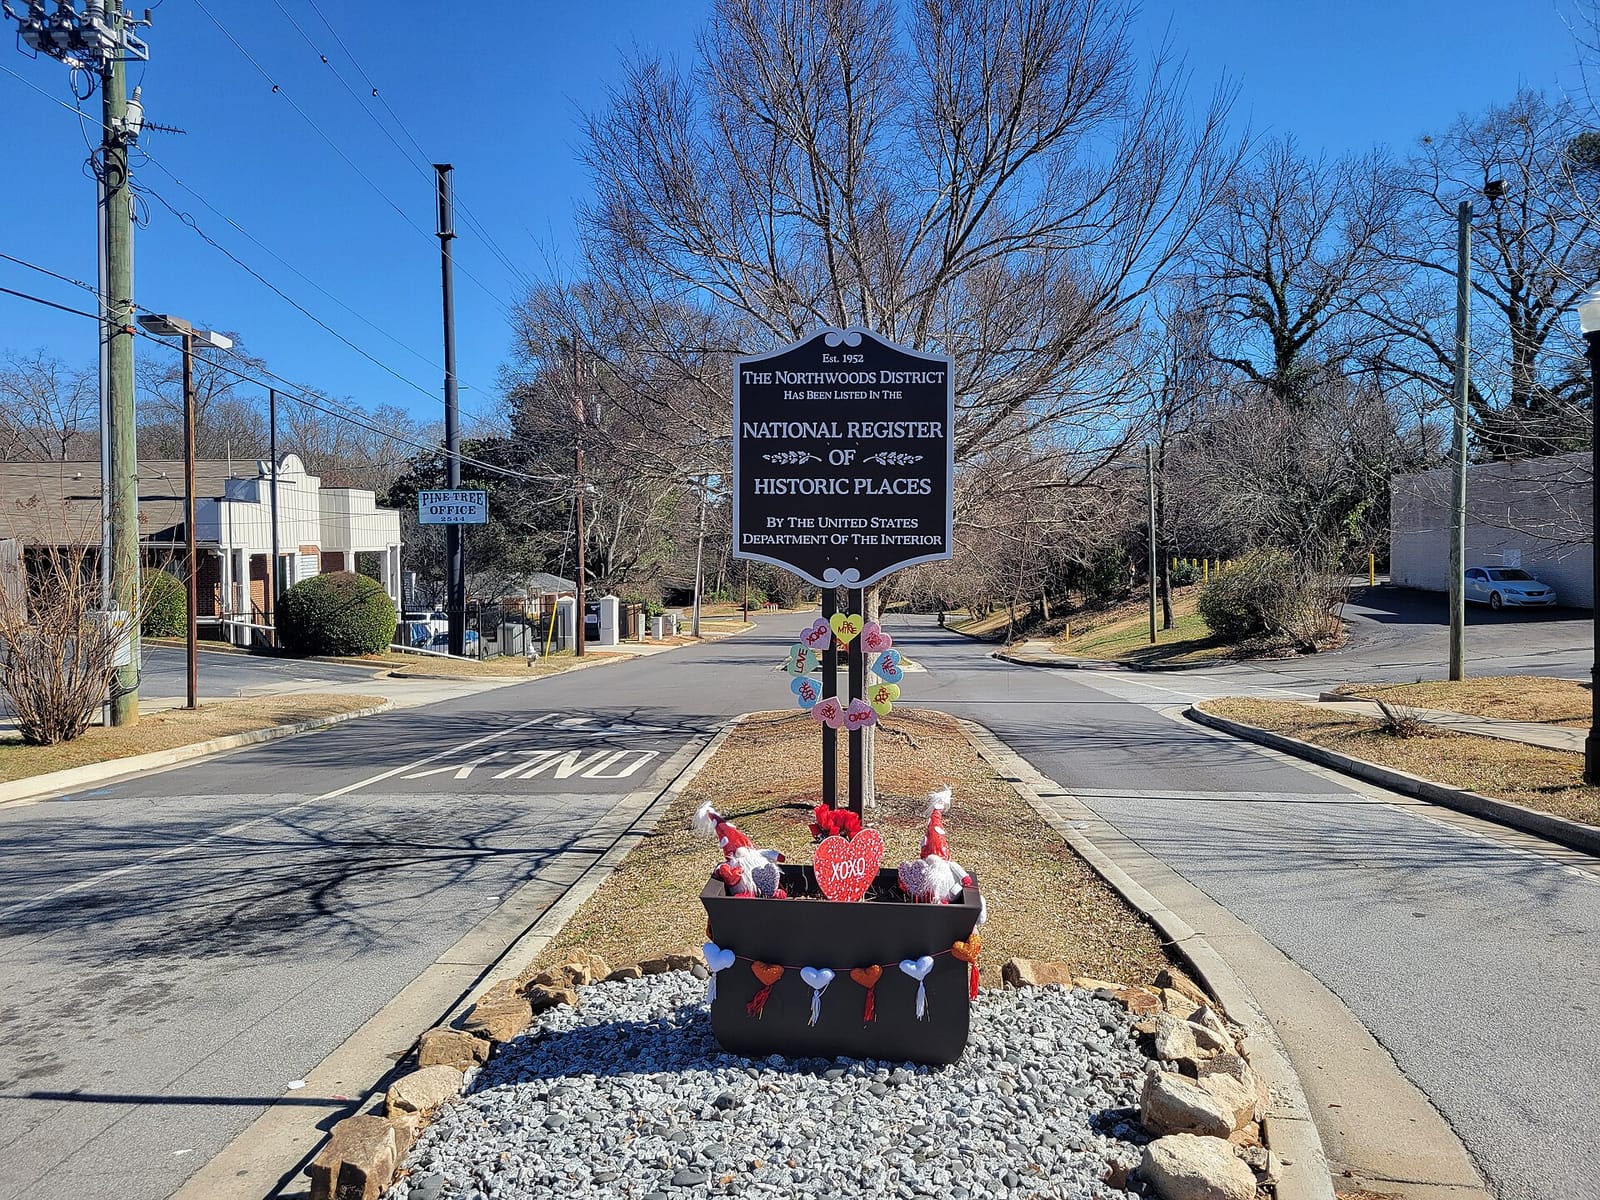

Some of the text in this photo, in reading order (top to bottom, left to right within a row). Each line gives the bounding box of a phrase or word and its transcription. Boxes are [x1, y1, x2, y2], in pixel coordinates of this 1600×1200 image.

[823, 354, 863, 363] Est. 1952
[743, 371, 944, 384] THE NORTHWOODS DISTRICT
[784, 391, 902, 399] HAS BEEN LISTED IN THE
[743, 422, 943, 438] NATIONAL REGISTER
[829, 450, 856, 465] OF
[754, 479, 931, 494] HISTORIC PLACES
[423, 493, 483, 506] PINE TREE
[430, 506, 476, 514] OFFICE
[767, 517, 918, 528] BY THE UNITED STATES
[743, 534, 942, 545] DEPARTMENT OF THE INTERIOR
[806, 625, 827, 645] XOXO
[794, 649, 807, 673] LOVE
[400, 750, 660, 779] ONLY
[831, 858, 866, 882] XOXO
